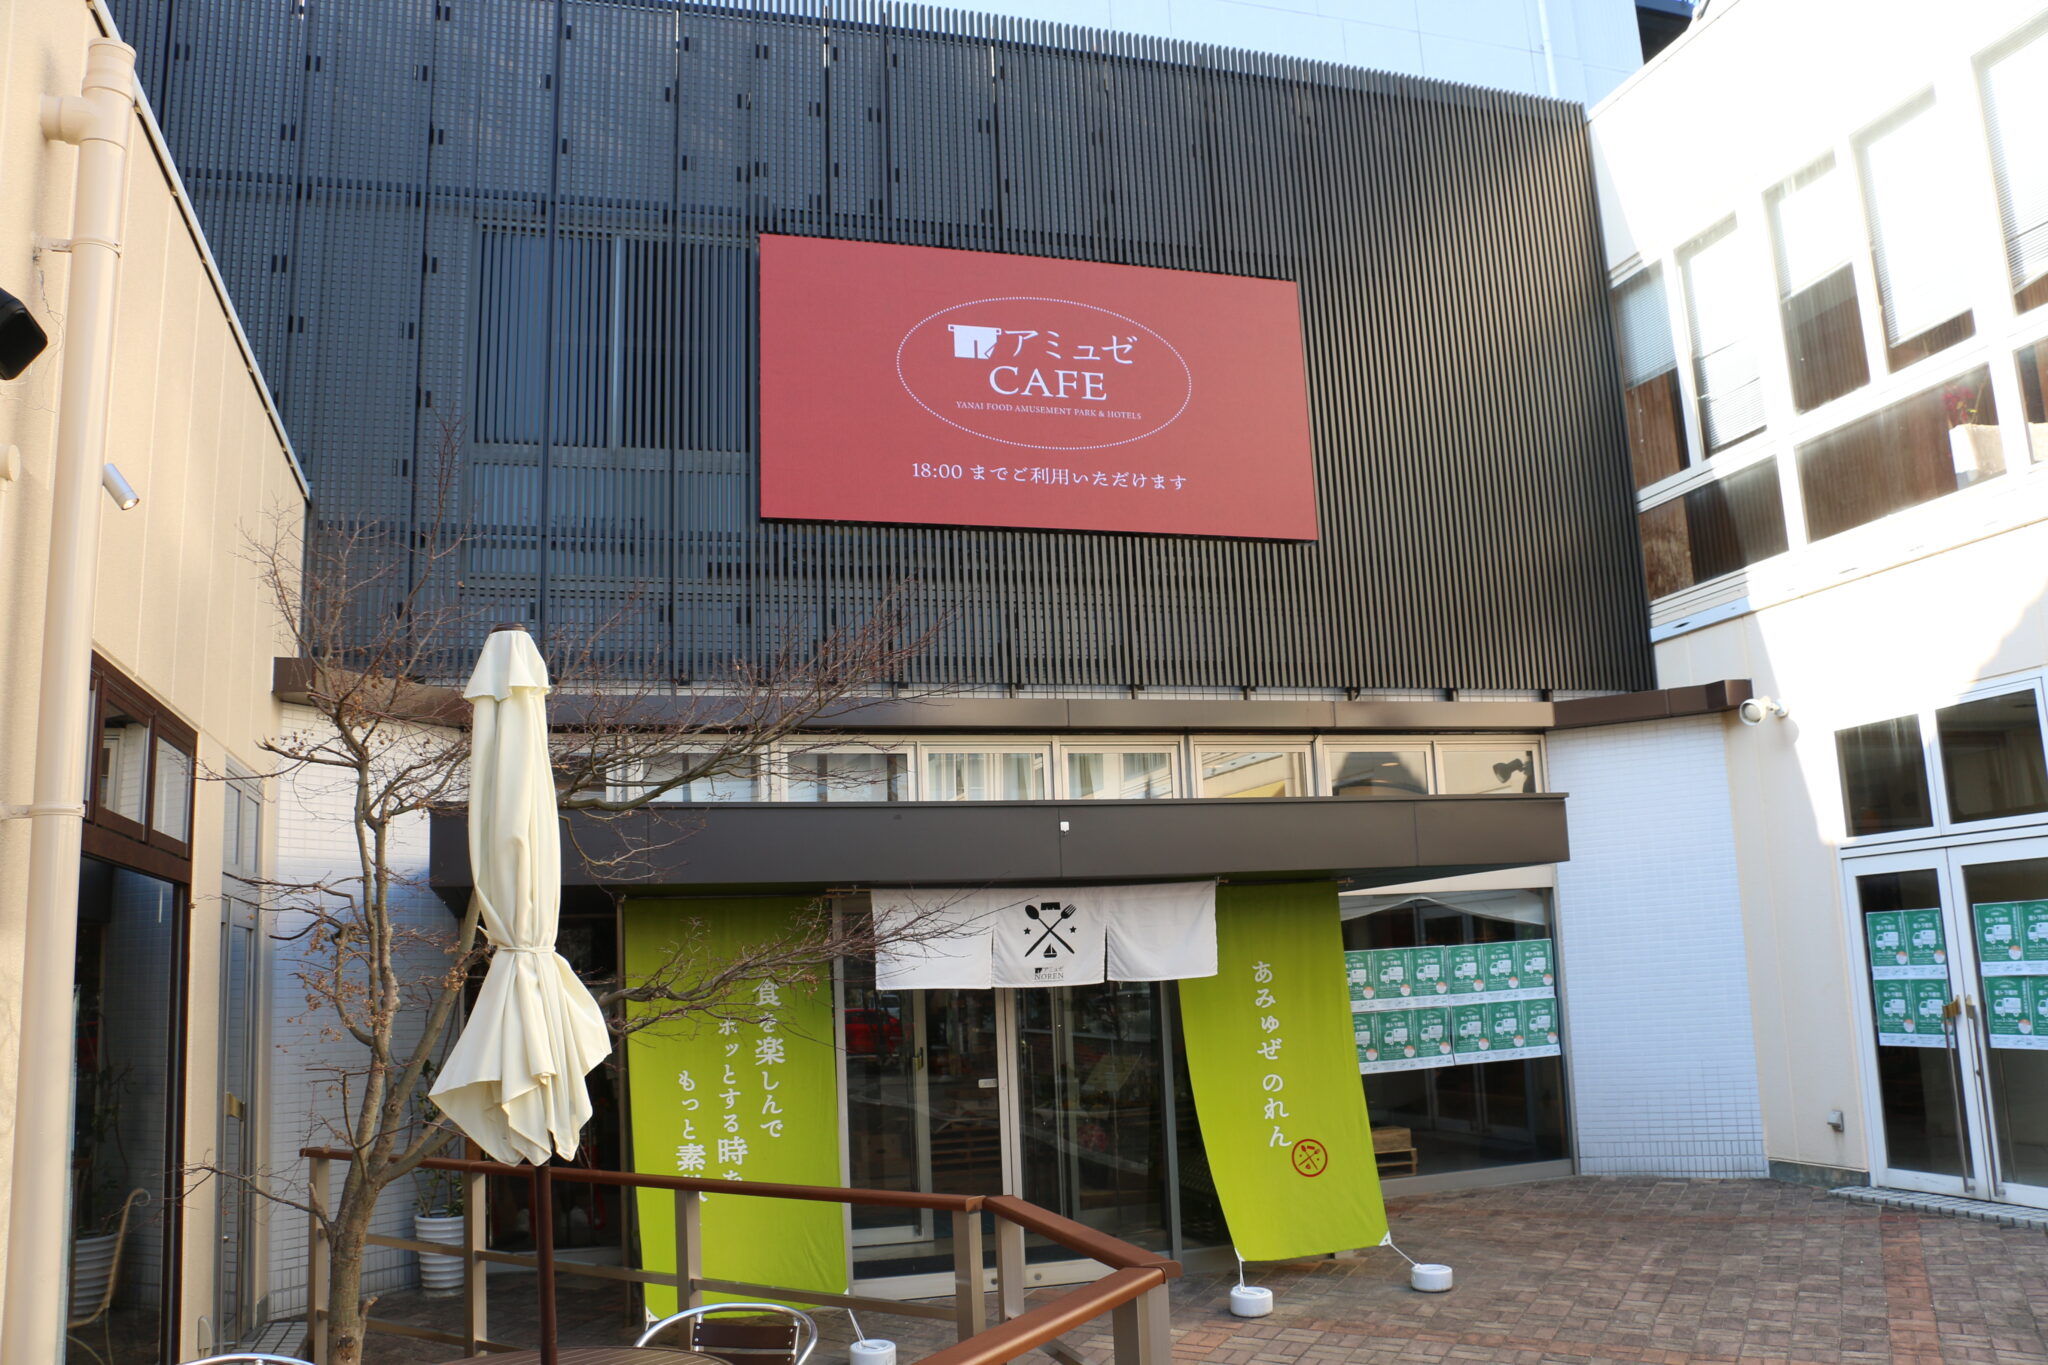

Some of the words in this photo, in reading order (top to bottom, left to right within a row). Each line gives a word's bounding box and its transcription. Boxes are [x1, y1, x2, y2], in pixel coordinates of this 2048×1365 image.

[1004, 329, 1138, 365] アミュゼ
[990, 365, 1107, 401] CAFE
[956, 400, 984, 410] YANAI
[986, 402, 1013, 412] FOOD
[1014, 404, 1072, 416] AMUSEMENT
[1074, 408, 1097, 417] PARK
[1107, 411, 1142, 420] HOTELS
[912, 462, 963, 479] 18:00
[970, 464, 1188, 491] までご利用いただけます
[752, 978, 786, 1138] 食を楽しんで
[676, 1070, 708, 1202] もっと素
